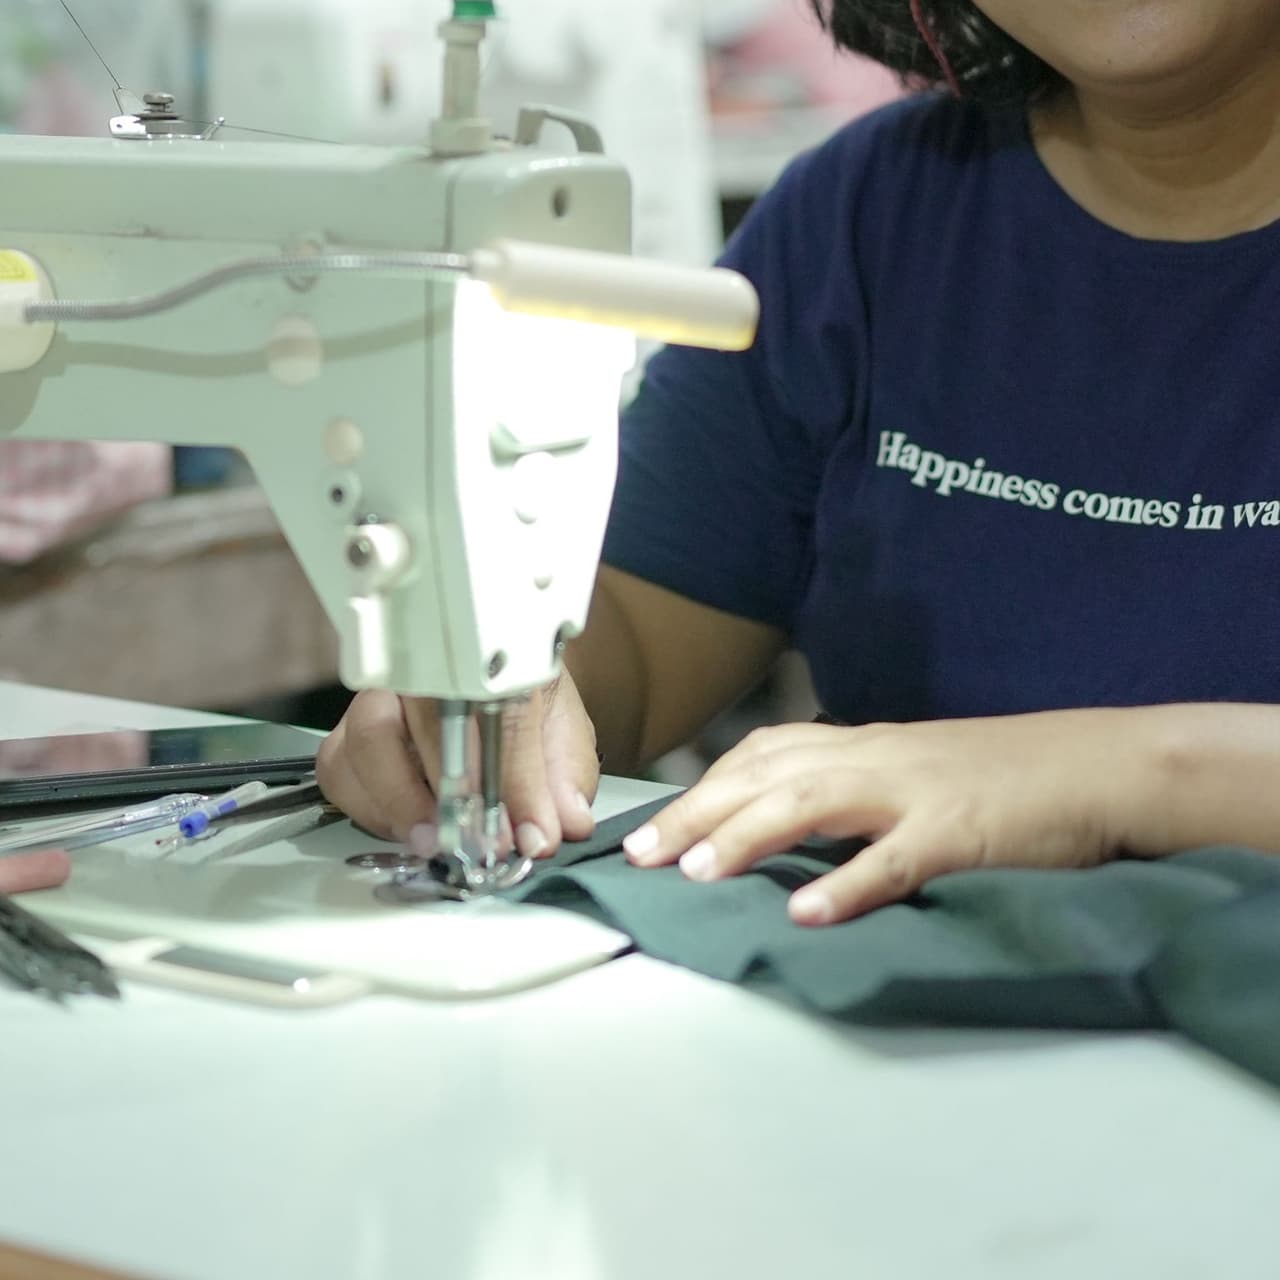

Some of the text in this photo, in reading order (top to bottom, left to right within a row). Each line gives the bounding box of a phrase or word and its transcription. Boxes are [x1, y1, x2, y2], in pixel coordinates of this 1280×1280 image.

[876, 431, 1060, 510] Happiness
[1063, 488, 1181, 528] comes
[1184, 493, 1224, 530] in
